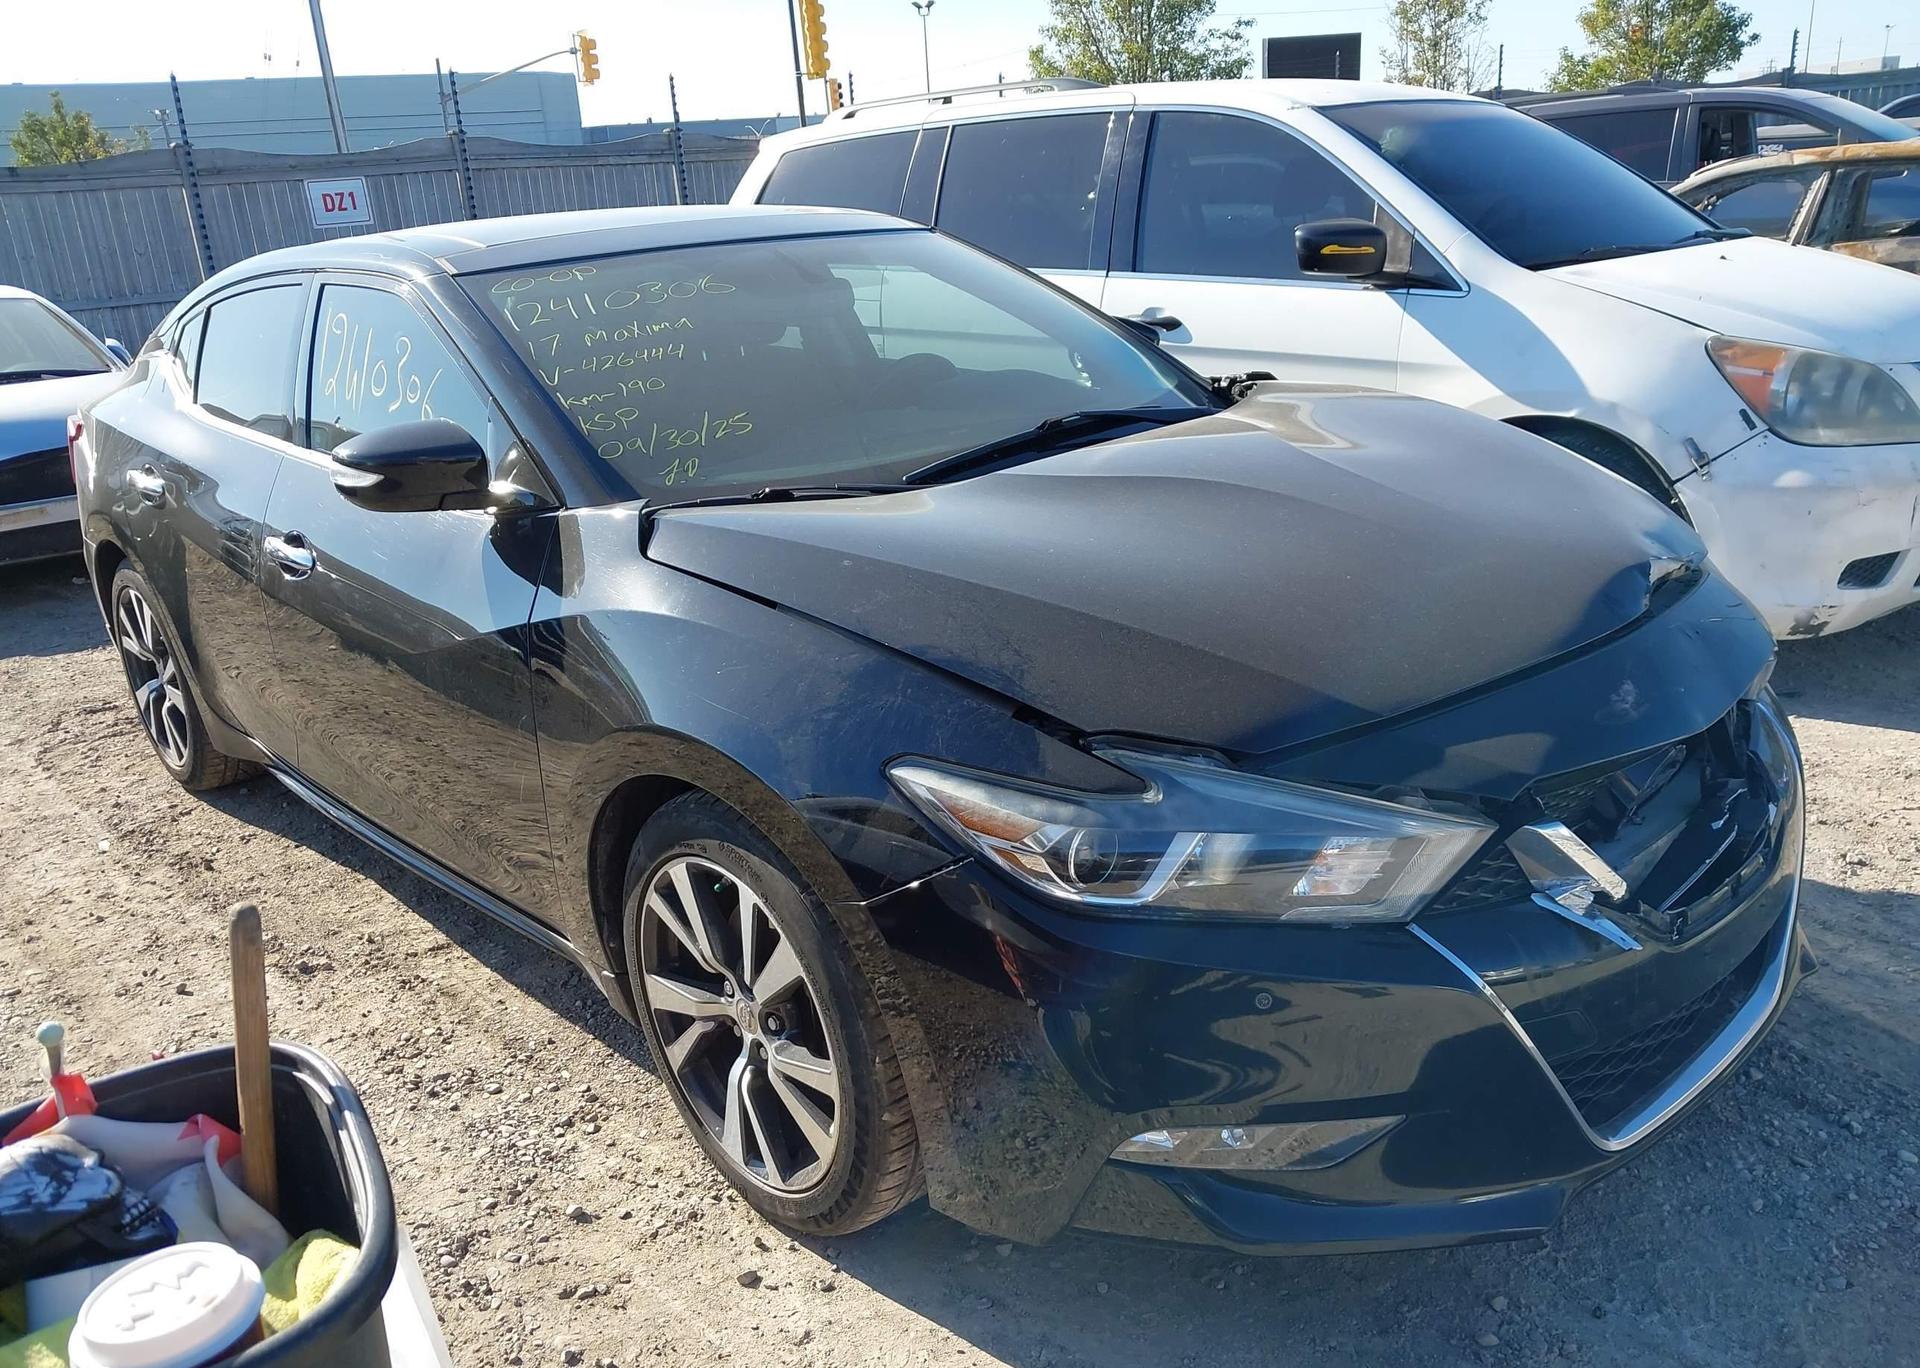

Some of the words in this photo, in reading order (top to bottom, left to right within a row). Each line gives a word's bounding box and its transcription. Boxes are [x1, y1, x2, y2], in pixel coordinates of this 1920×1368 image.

[321, 191, 357, 213] DZ1
[504, 273, 737, 331] 12410306
[319, 306, 443, 421] 12410306
[539, 343, 686, 387] V-426444
[597, 410, 753, 460] 09/30/25
